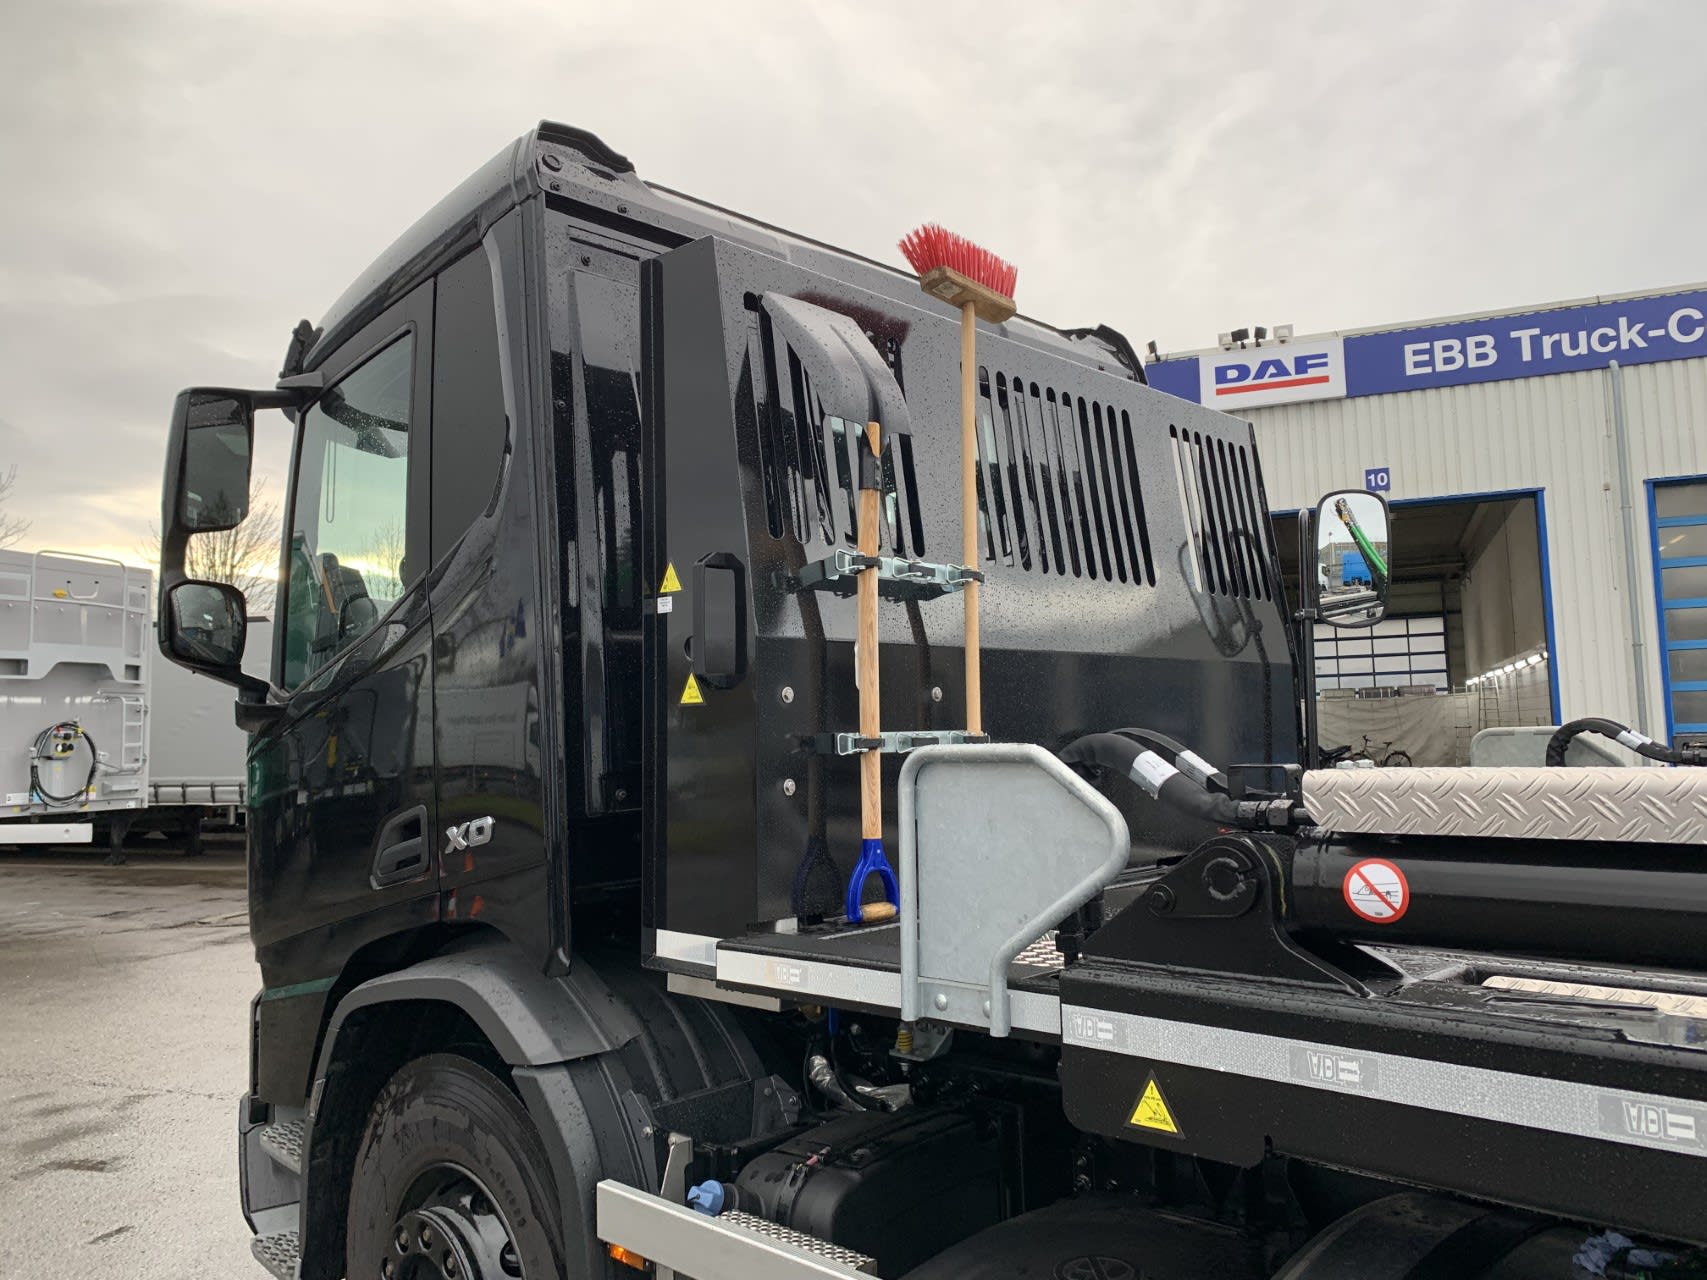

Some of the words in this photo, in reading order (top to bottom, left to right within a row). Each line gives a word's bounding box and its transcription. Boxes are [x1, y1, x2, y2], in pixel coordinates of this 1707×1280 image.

[1215, 353, 1328, 385] DAF
[1404, 334, 1498, 376] EBB
[1367, 472, 1388, 487] 10
[1621, 1102, 1681, 1141] VDL
